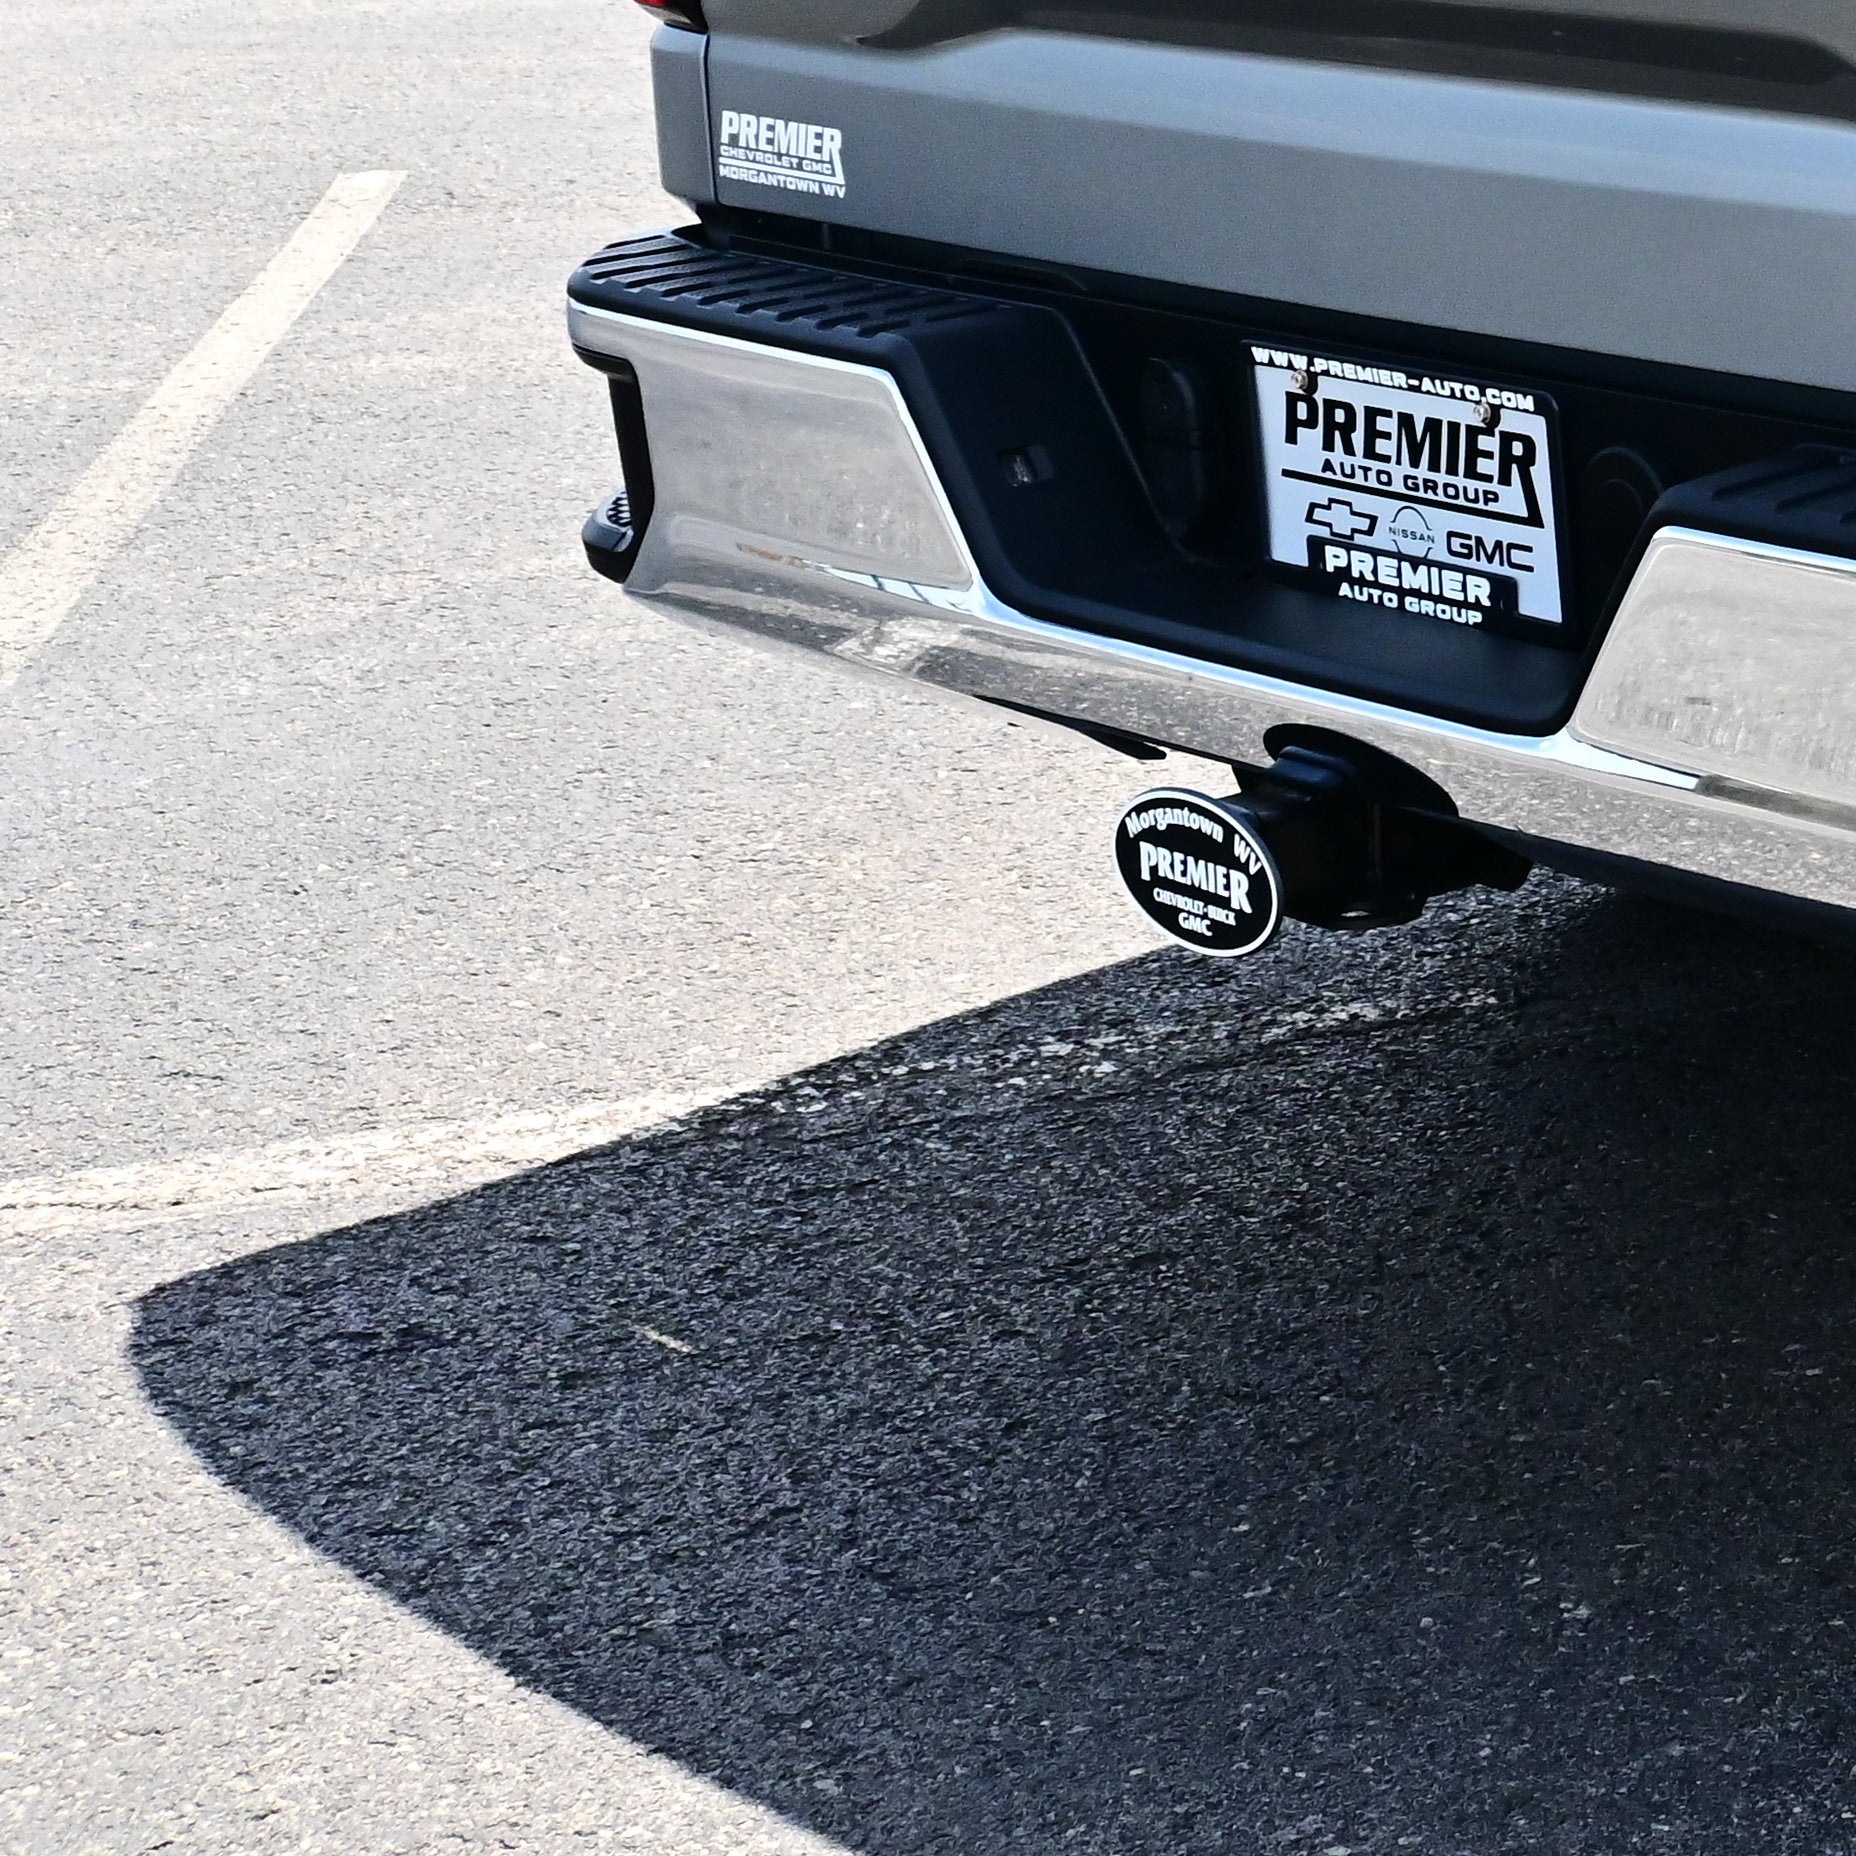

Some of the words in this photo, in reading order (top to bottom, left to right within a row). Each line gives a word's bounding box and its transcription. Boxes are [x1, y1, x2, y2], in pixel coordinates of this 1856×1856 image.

[719, 145, 799, 169] CHEVROLET
[802, 158, 833, 175] GMC
[720, 110, 843, 164] PREMIER
[719, 164, 821, 195] MORGANTOWN
[822, 183, 847, 200] WV
[1251, 346, 1535, 412] WWW.PREMIER-AUTO.COM
[1284, 389, 1539, 489] PREMIER
[1321, 457, 1394, 488] AUTO
[1402, 473, 1500, 507] GROUP
[1388, 525, 1436, 545] NISSAN
[1446, 530, 1535, 574] GMC
[1323, 544, 1492, 608] PREMIER
[1337, 581, 1399, 609] AUTO
[1403, 595, 1484, 626] GROUP
[1124, 806, 1224, 843] Morgantown
[1233, 833, 1263, 876] WV
[1139, 840, 1253, 914] PREMIER
[1178, 912, 1213, 937] GMC
